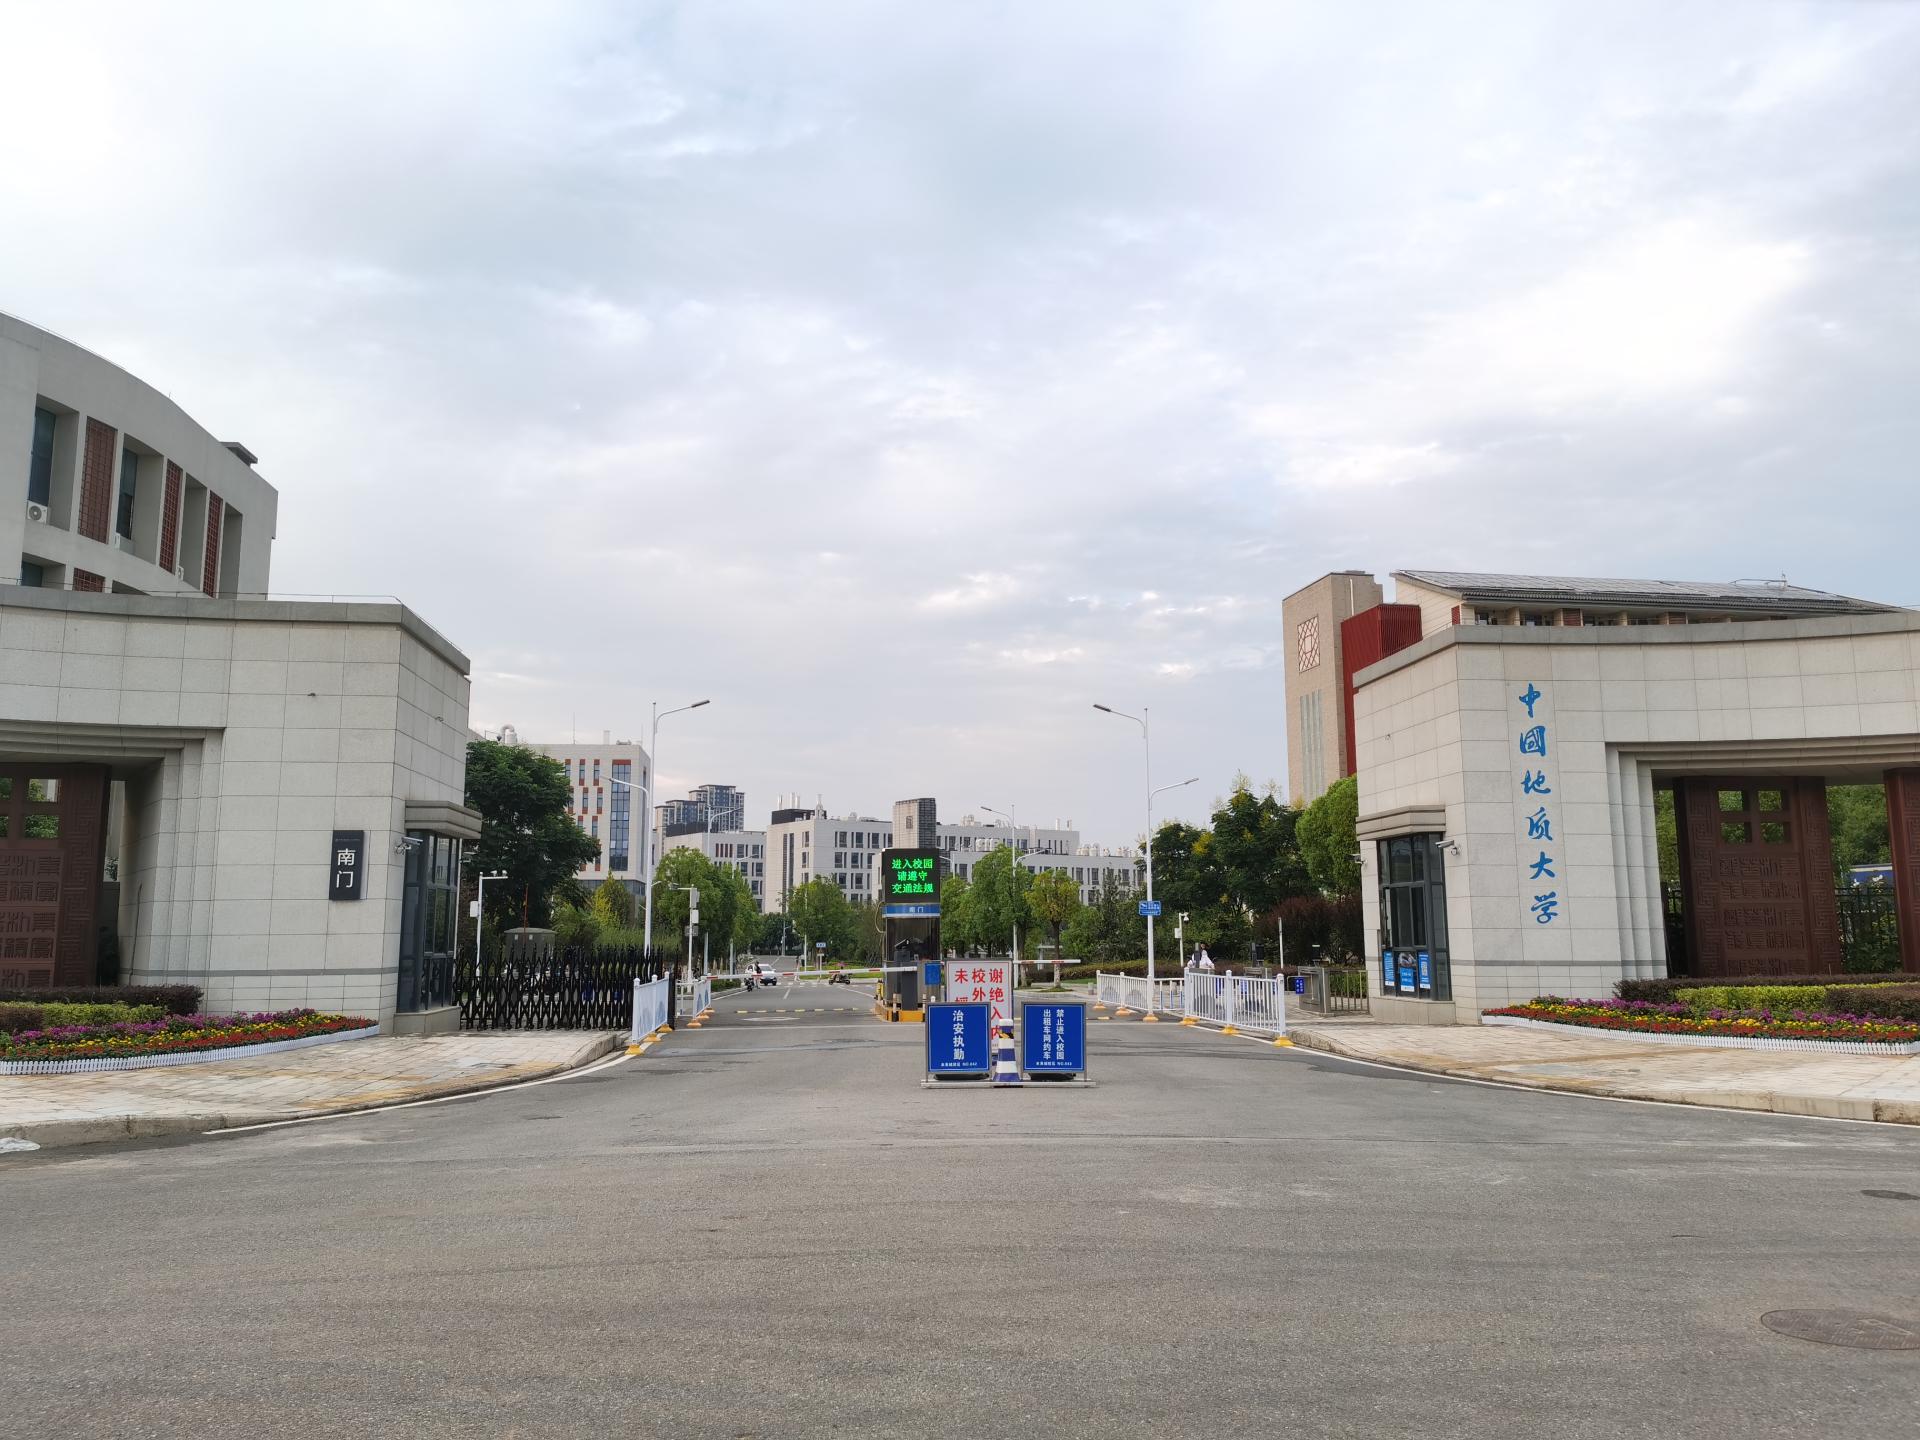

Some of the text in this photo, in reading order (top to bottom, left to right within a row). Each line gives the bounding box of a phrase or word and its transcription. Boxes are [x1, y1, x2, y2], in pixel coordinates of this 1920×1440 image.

[336, 847, 356, 889] 南门
[891, 858, 933, 869] 进入校园
[897, 870, 928, 881] 请遵守
[891, 883, 934, 894] 交通法规
[952, 1009, 965, 1060] 治安执勤
[1043, 1009, 1052, 1060] 出租车网约车
[1056, 1009, 1065, 1060] 禁止进入校园
